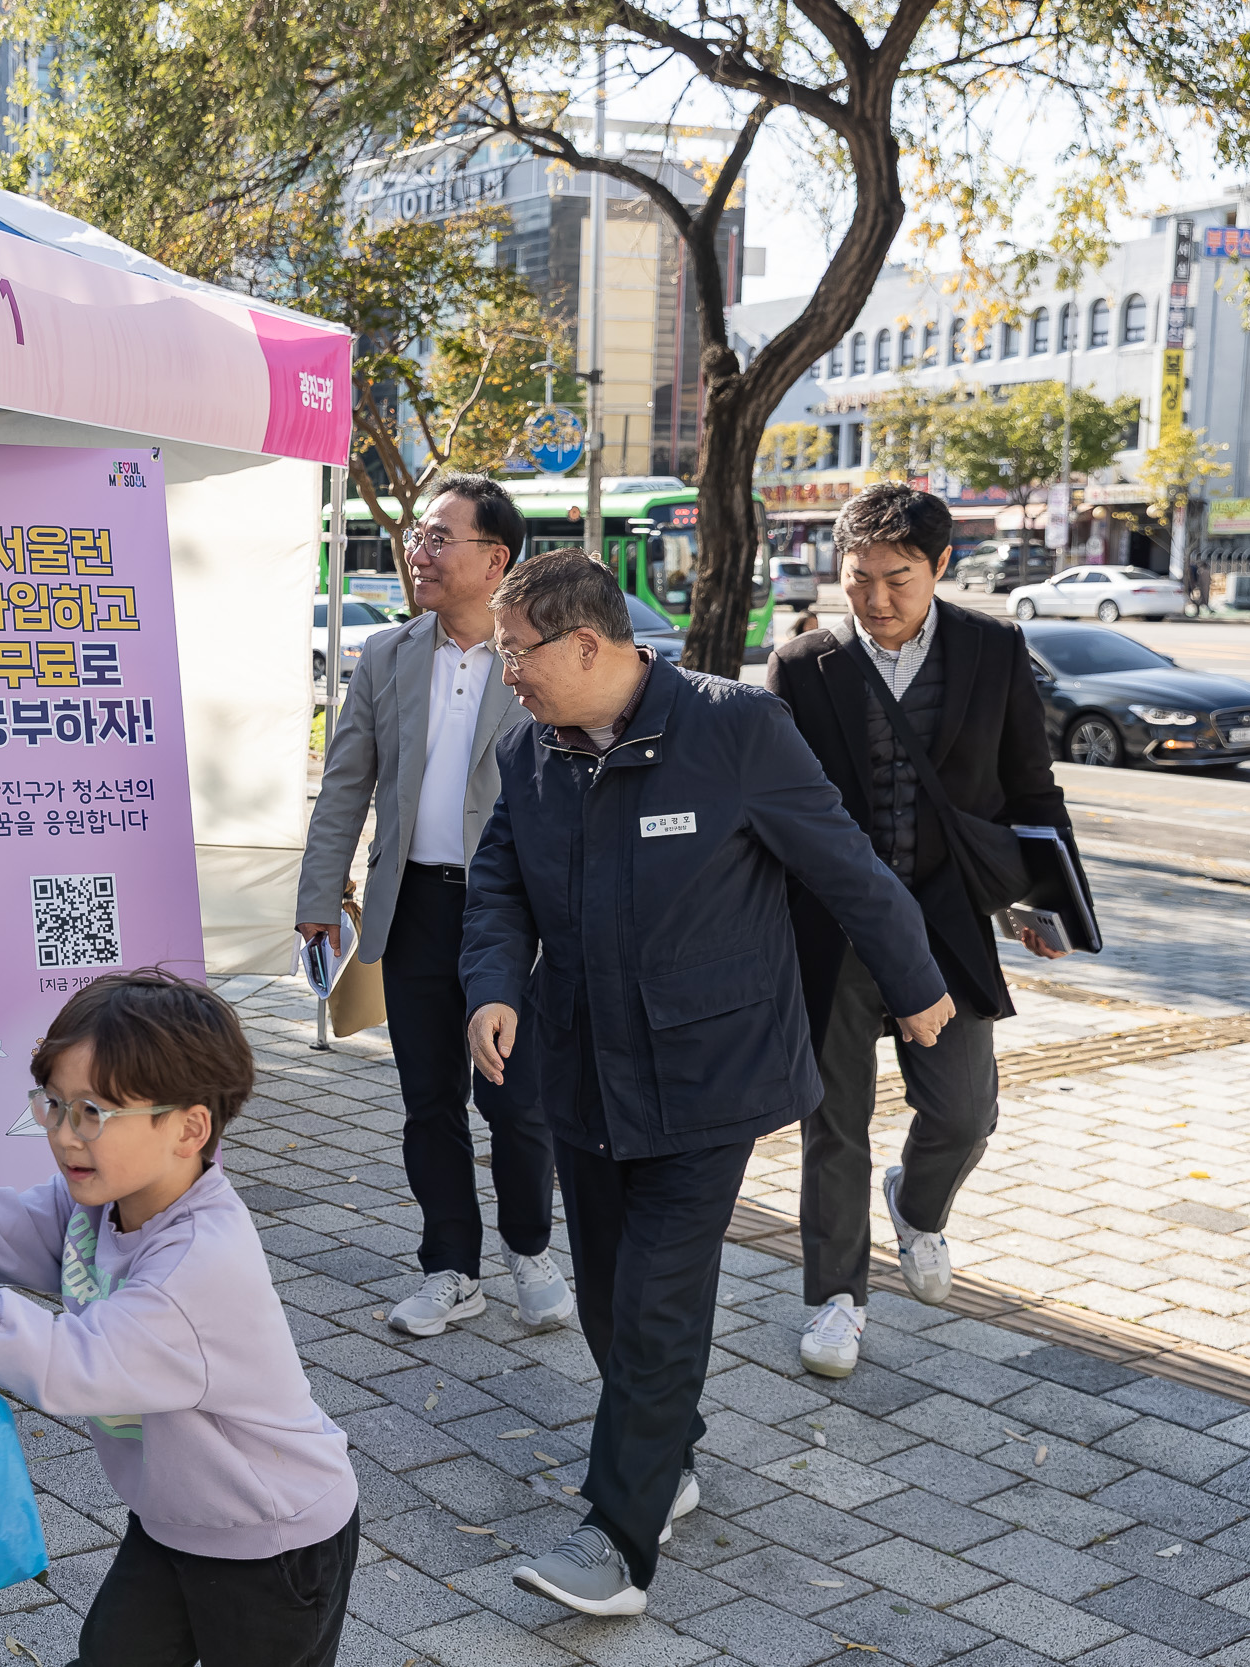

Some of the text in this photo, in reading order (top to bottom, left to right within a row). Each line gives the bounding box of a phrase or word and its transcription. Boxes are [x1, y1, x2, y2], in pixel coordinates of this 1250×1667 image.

[299, 371, 334, 413] 광진구청
[71, 778, 155, 806] 청소년의
[43, 808, 149, 836] 응원합니다
